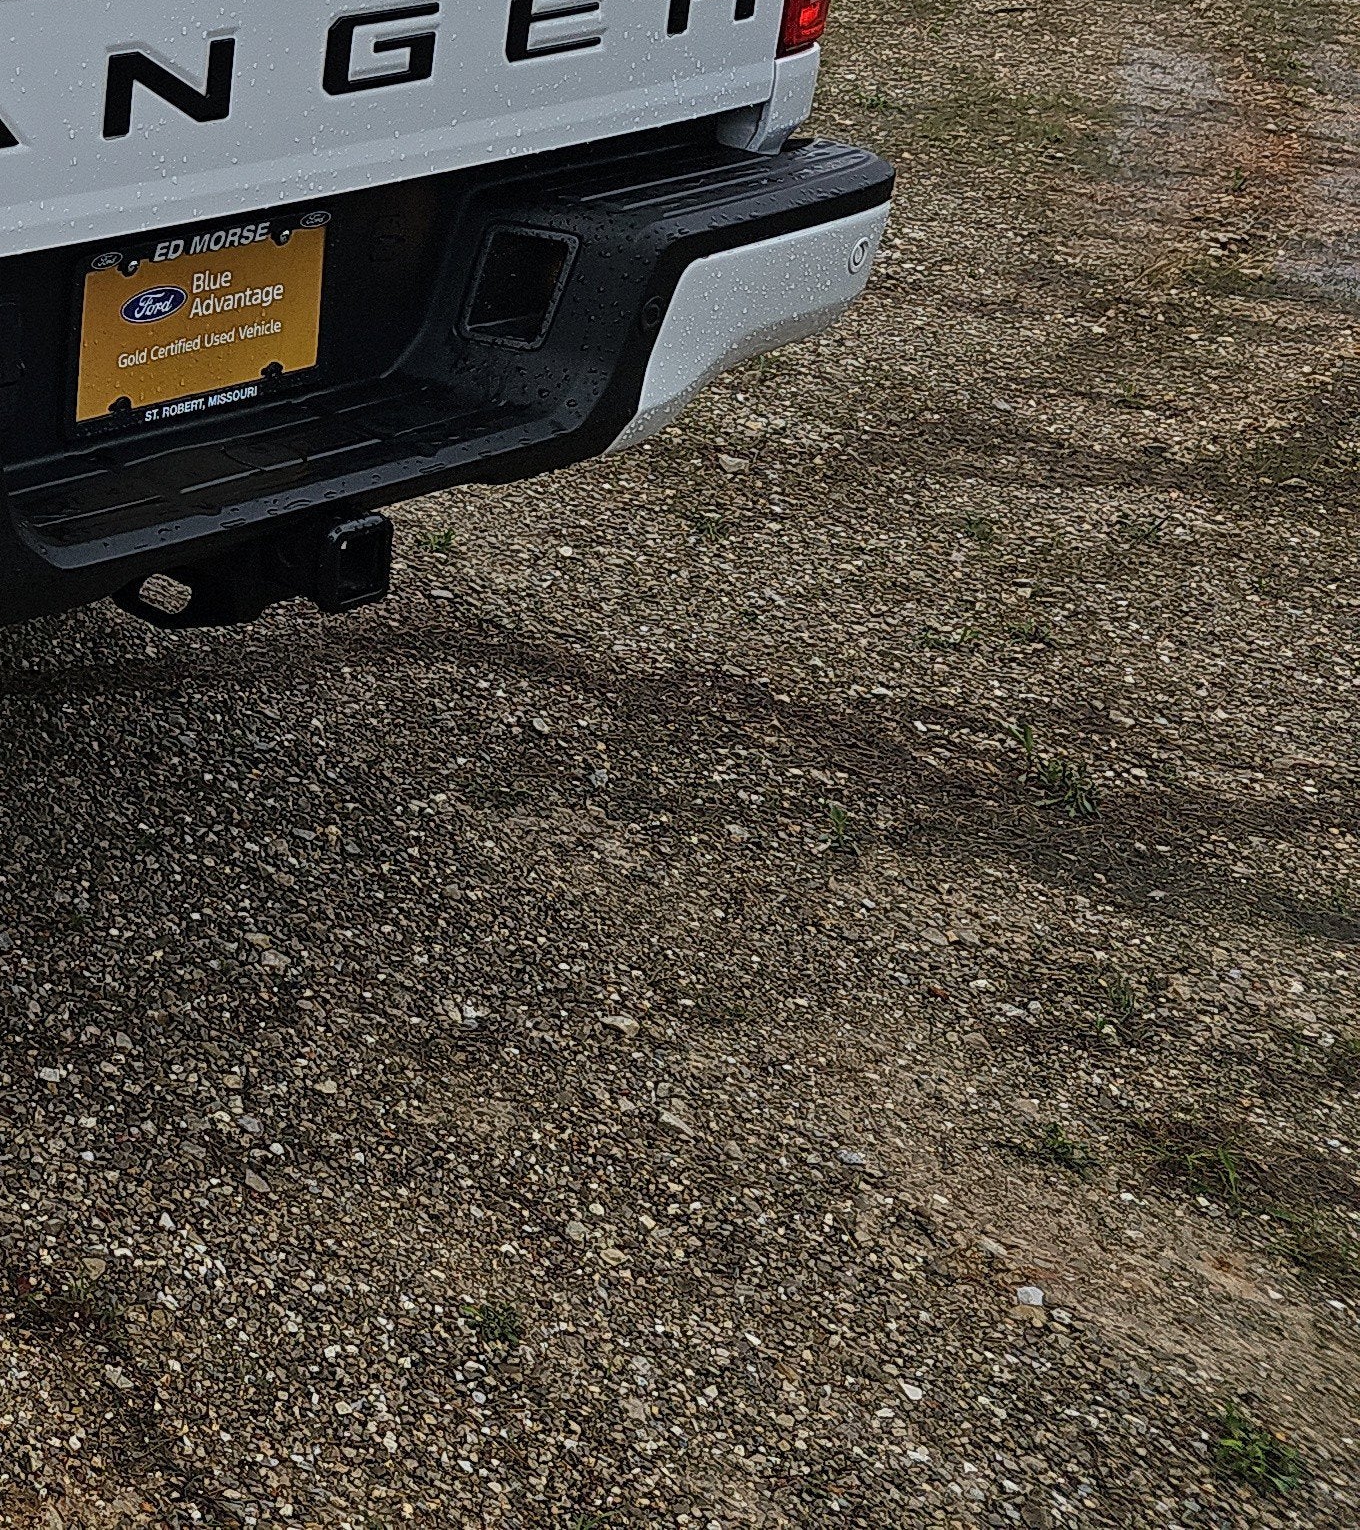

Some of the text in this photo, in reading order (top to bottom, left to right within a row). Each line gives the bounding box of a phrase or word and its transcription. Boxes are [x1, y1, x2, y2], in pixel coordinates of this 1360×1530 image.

[153, 222, 271, 262] ED MORSE
[192, 270, 232, 293] Blue
[134, 291, 175, 319] Ford
[189, 283, 284, 319] Advantage
[118, 319, 282, 368] Gold Certified Used Vehicle
[144, 386, 258, 422] ST. ROBERT, MISSOURI
